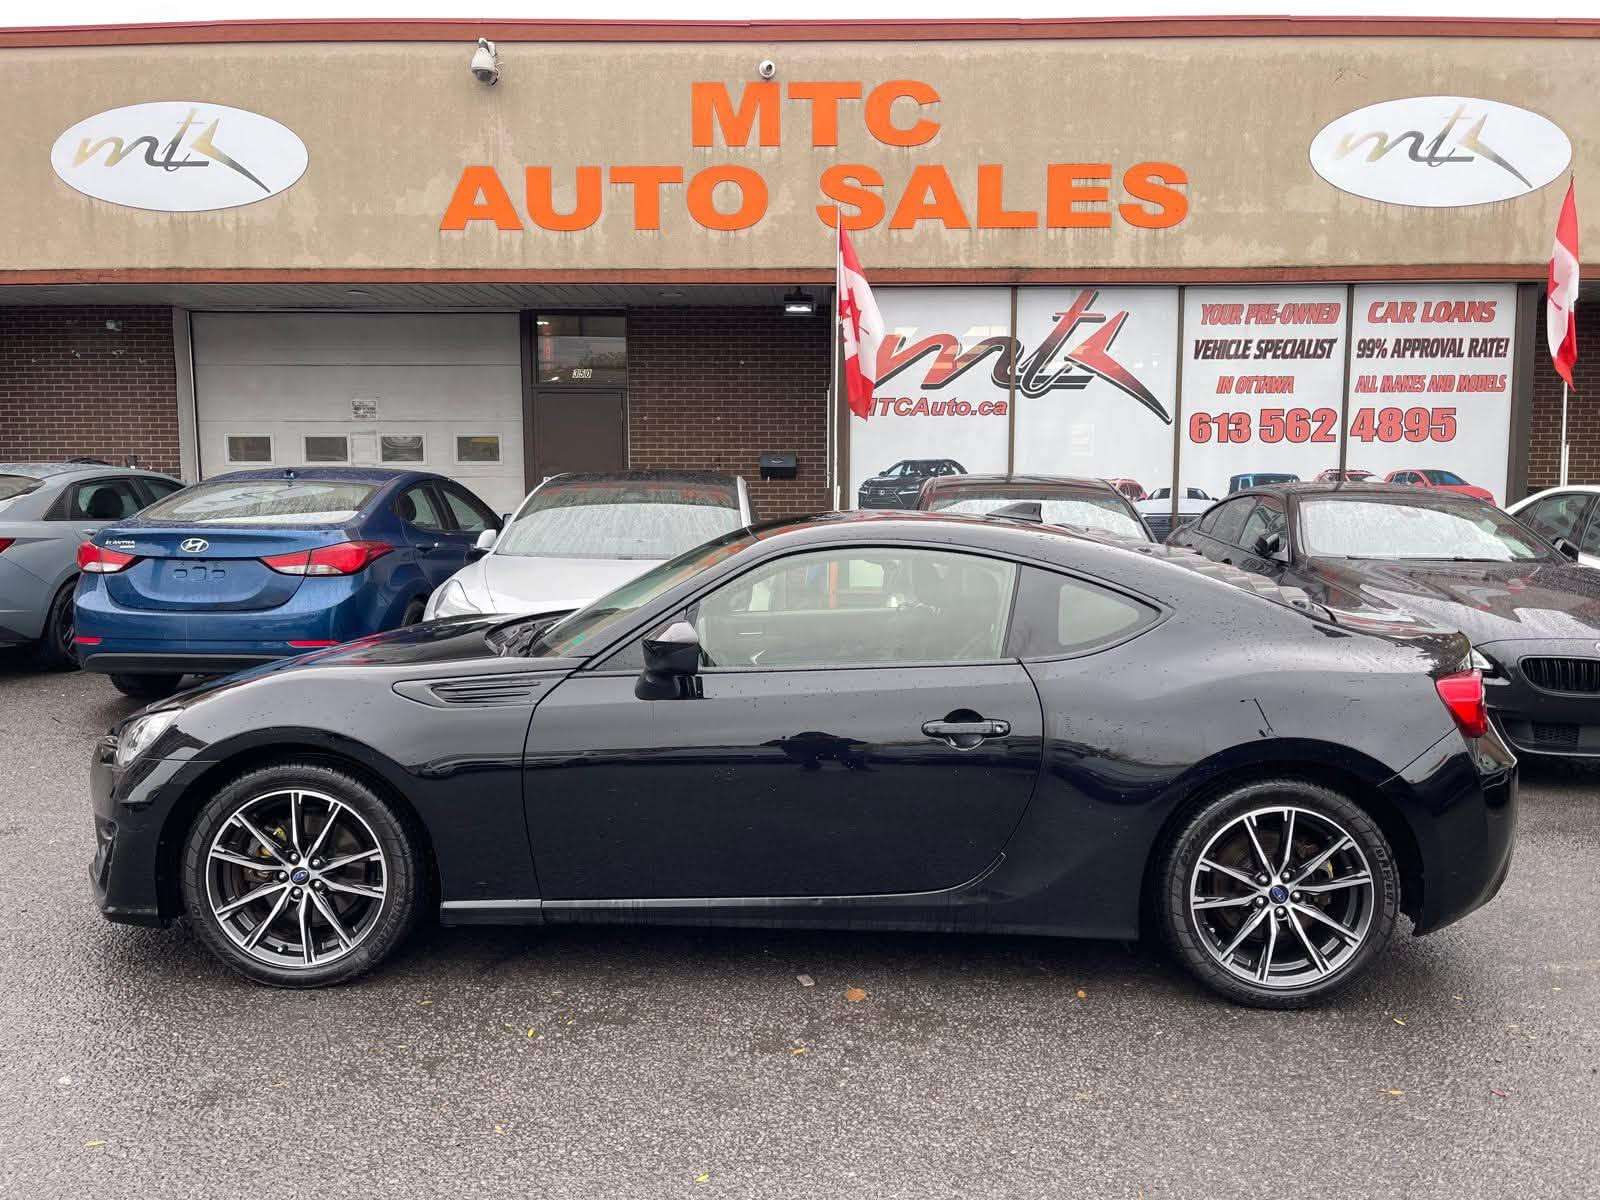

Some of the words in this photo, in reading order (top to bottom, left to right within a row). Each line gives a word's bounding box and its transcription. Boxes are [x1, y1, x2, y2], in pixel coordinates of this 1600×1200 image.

[691, 80, 941, 147] MTC
[439, 164, 769, 232] AUTO
[815, 161, 1190, 231] SALES
[1200, 303, 1244, 325] YOUR
[1244, 302, 1341, 325] PRE-OWNED
[1367, 301, 1418, 323] CAR
[1420, 300, 1497, 323] LOANS
[1193, 339, 1253, 360] VEHICLE
[1253, 337, 1338, 359] SPECIALIST
[1356, 338, 1388, 359] 99%
[1390, 338, 1465, 358] APPROVAL
[1467, 337, 1510, 358] RATE!
[1216, 375, 1235, 394] IN
[1234, 375, 1295, 394] OTTAWA
[1354, 375, 1378, 393] ALL
[1379, 374, 1427, 393] MAKES
[1427, 374, 1456, 393] AND
[1456, 374, 1508, 393] MODELS
[1189, 412, 1252, 444] 613
[1258, 408, 1338, 444] 562
[1349, 407, 1458, 443] 4895
